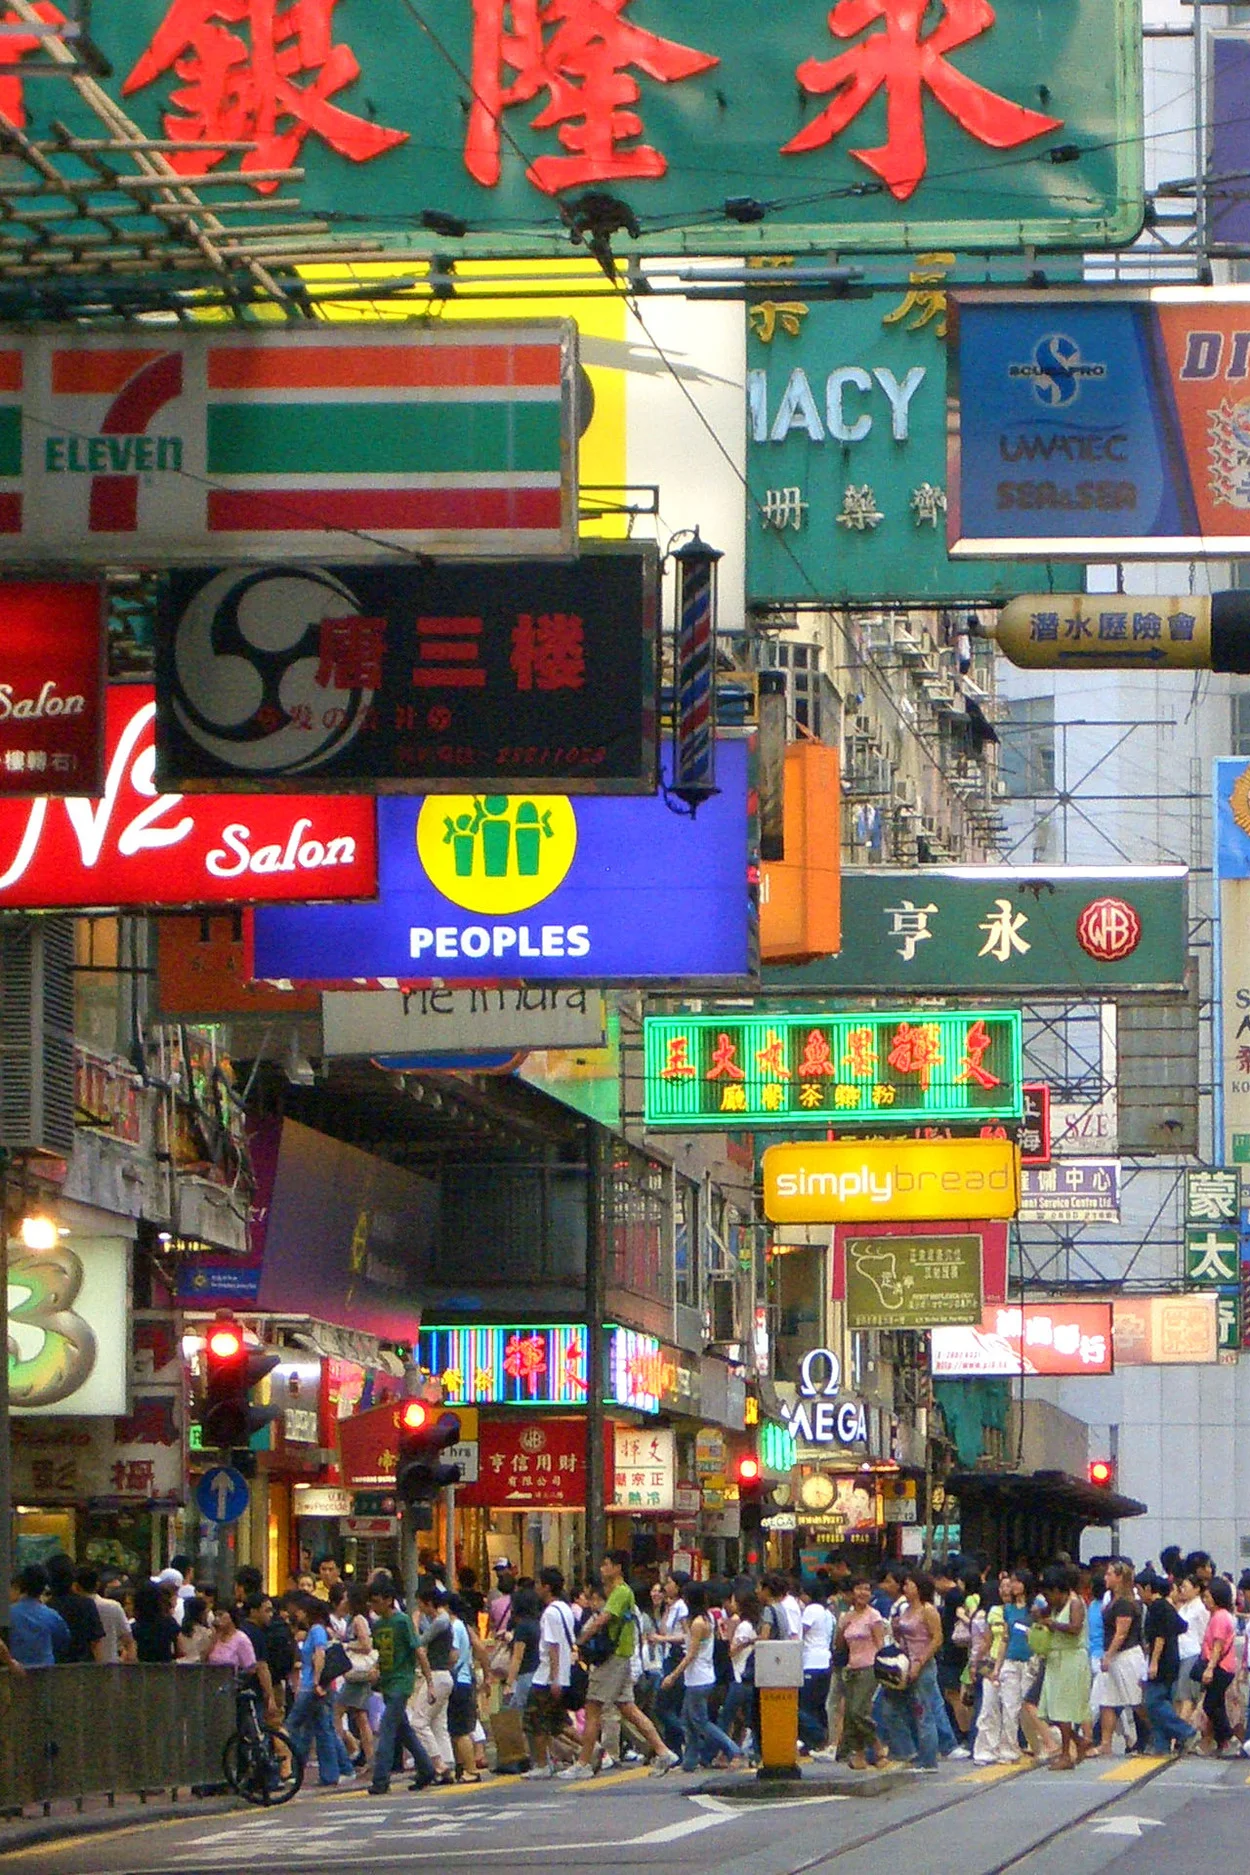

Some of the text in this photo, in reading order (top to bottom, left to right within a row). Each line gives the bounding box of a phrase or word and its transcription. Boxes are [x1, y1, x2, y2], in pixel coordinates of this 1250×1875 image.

[205, 819, 357, 878] Salon
[409, 926, 591, 959] PEOPLES
[479, 1453, 586, 1473] 亨信用財
